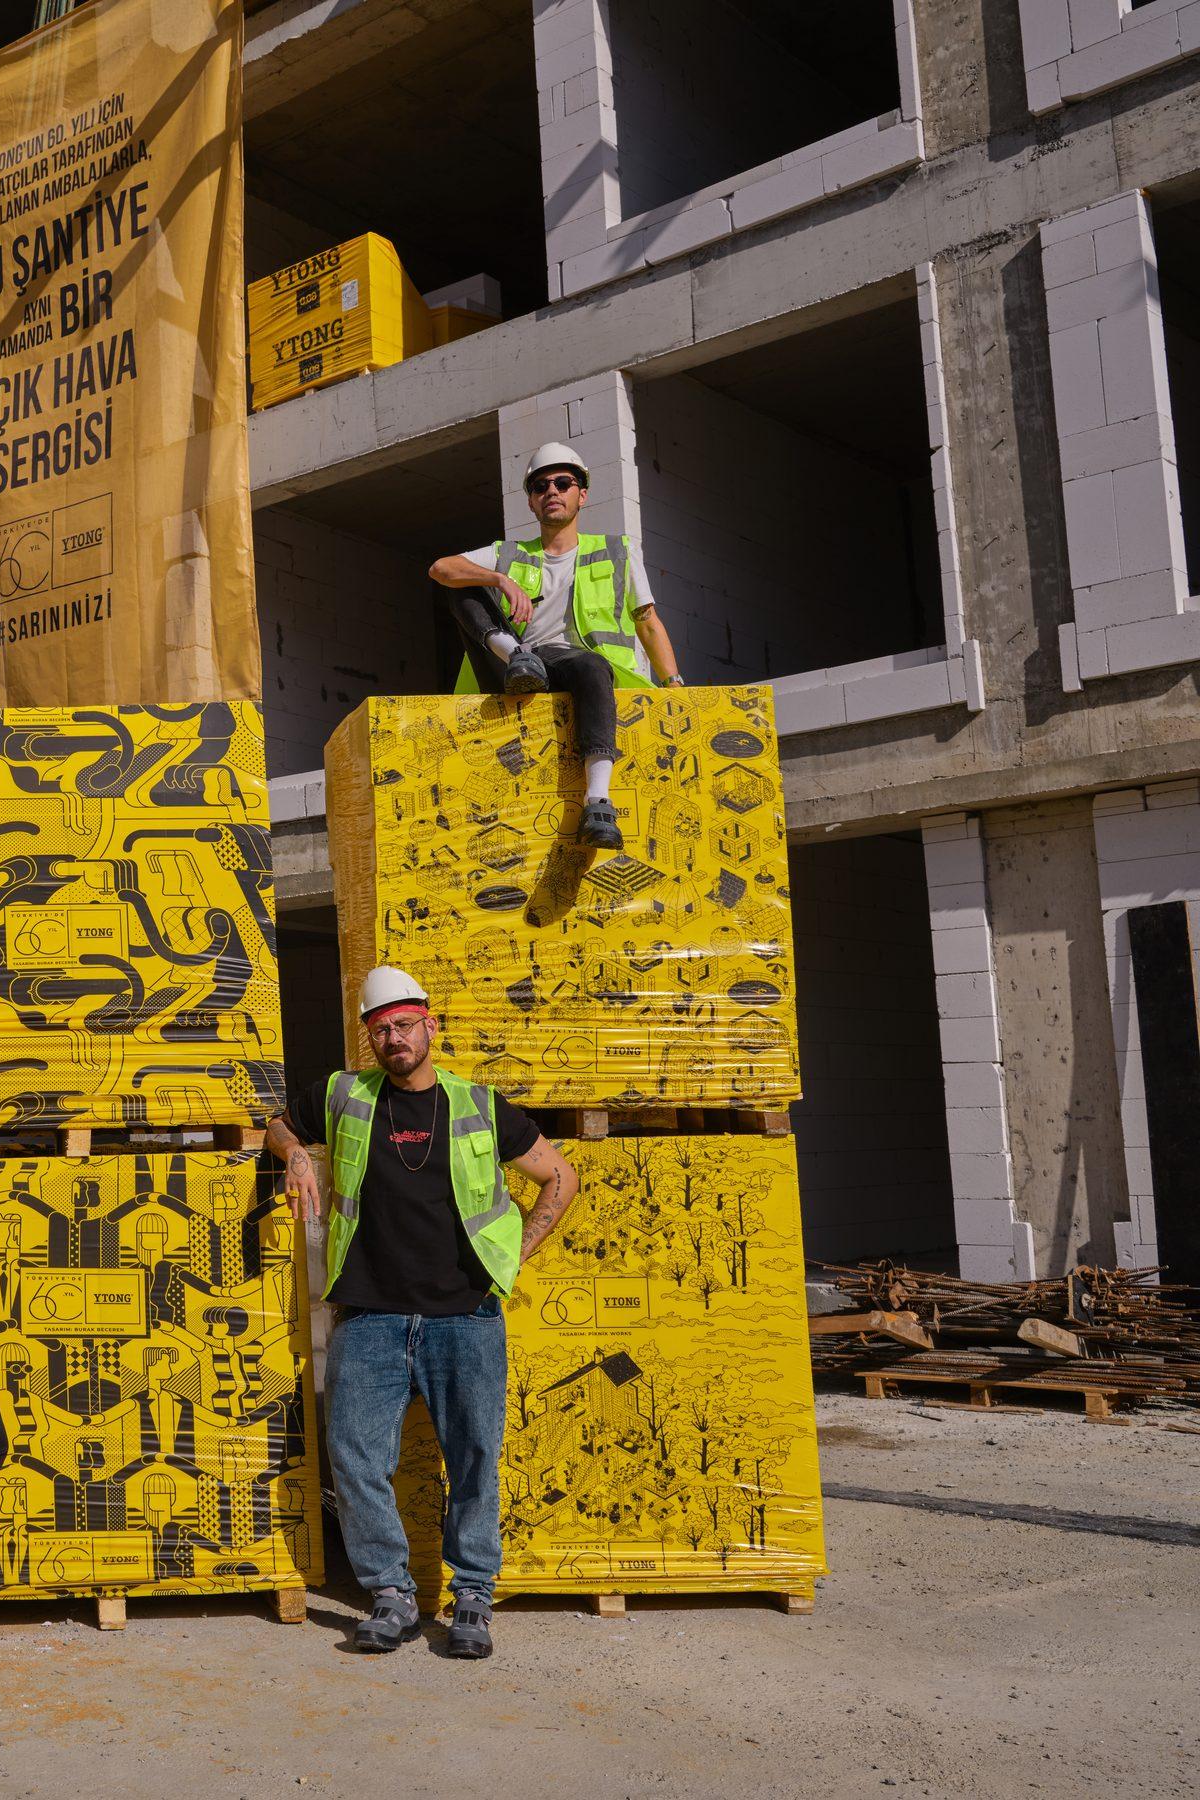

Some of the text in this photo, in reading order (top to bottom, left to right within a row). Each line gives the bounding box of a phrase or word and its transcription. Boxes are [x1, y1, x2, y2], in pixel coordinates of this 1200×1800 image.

[47, 124, 67, 149] 60.
[71, 108, 95, 137] YILI
[98, 92, 125, 124] İÇİN
[52, 116, 134, 173] TARAFINDAN
[43, 139, 152, 205] AMBALAJLARLA,
[12, 180, 149, 297] ŞANTİYE
[270, 247, 341, 292] YTONG
[23, 267, 113, 338] AYNI BİR
[272, 318, 344, 362] YTONG
[53, 328, 138, 409] HAVA
[61, 527, 103, 552] YTONG
[76, 928, 113, 936] YTONG
[605, 1047, 641, 1055] YTONG
[94, 1293, 132, 1302] YTONG
[603, 1297, 641, 1306] YTONG
[619, 1560, 656, 1569] YTONG
